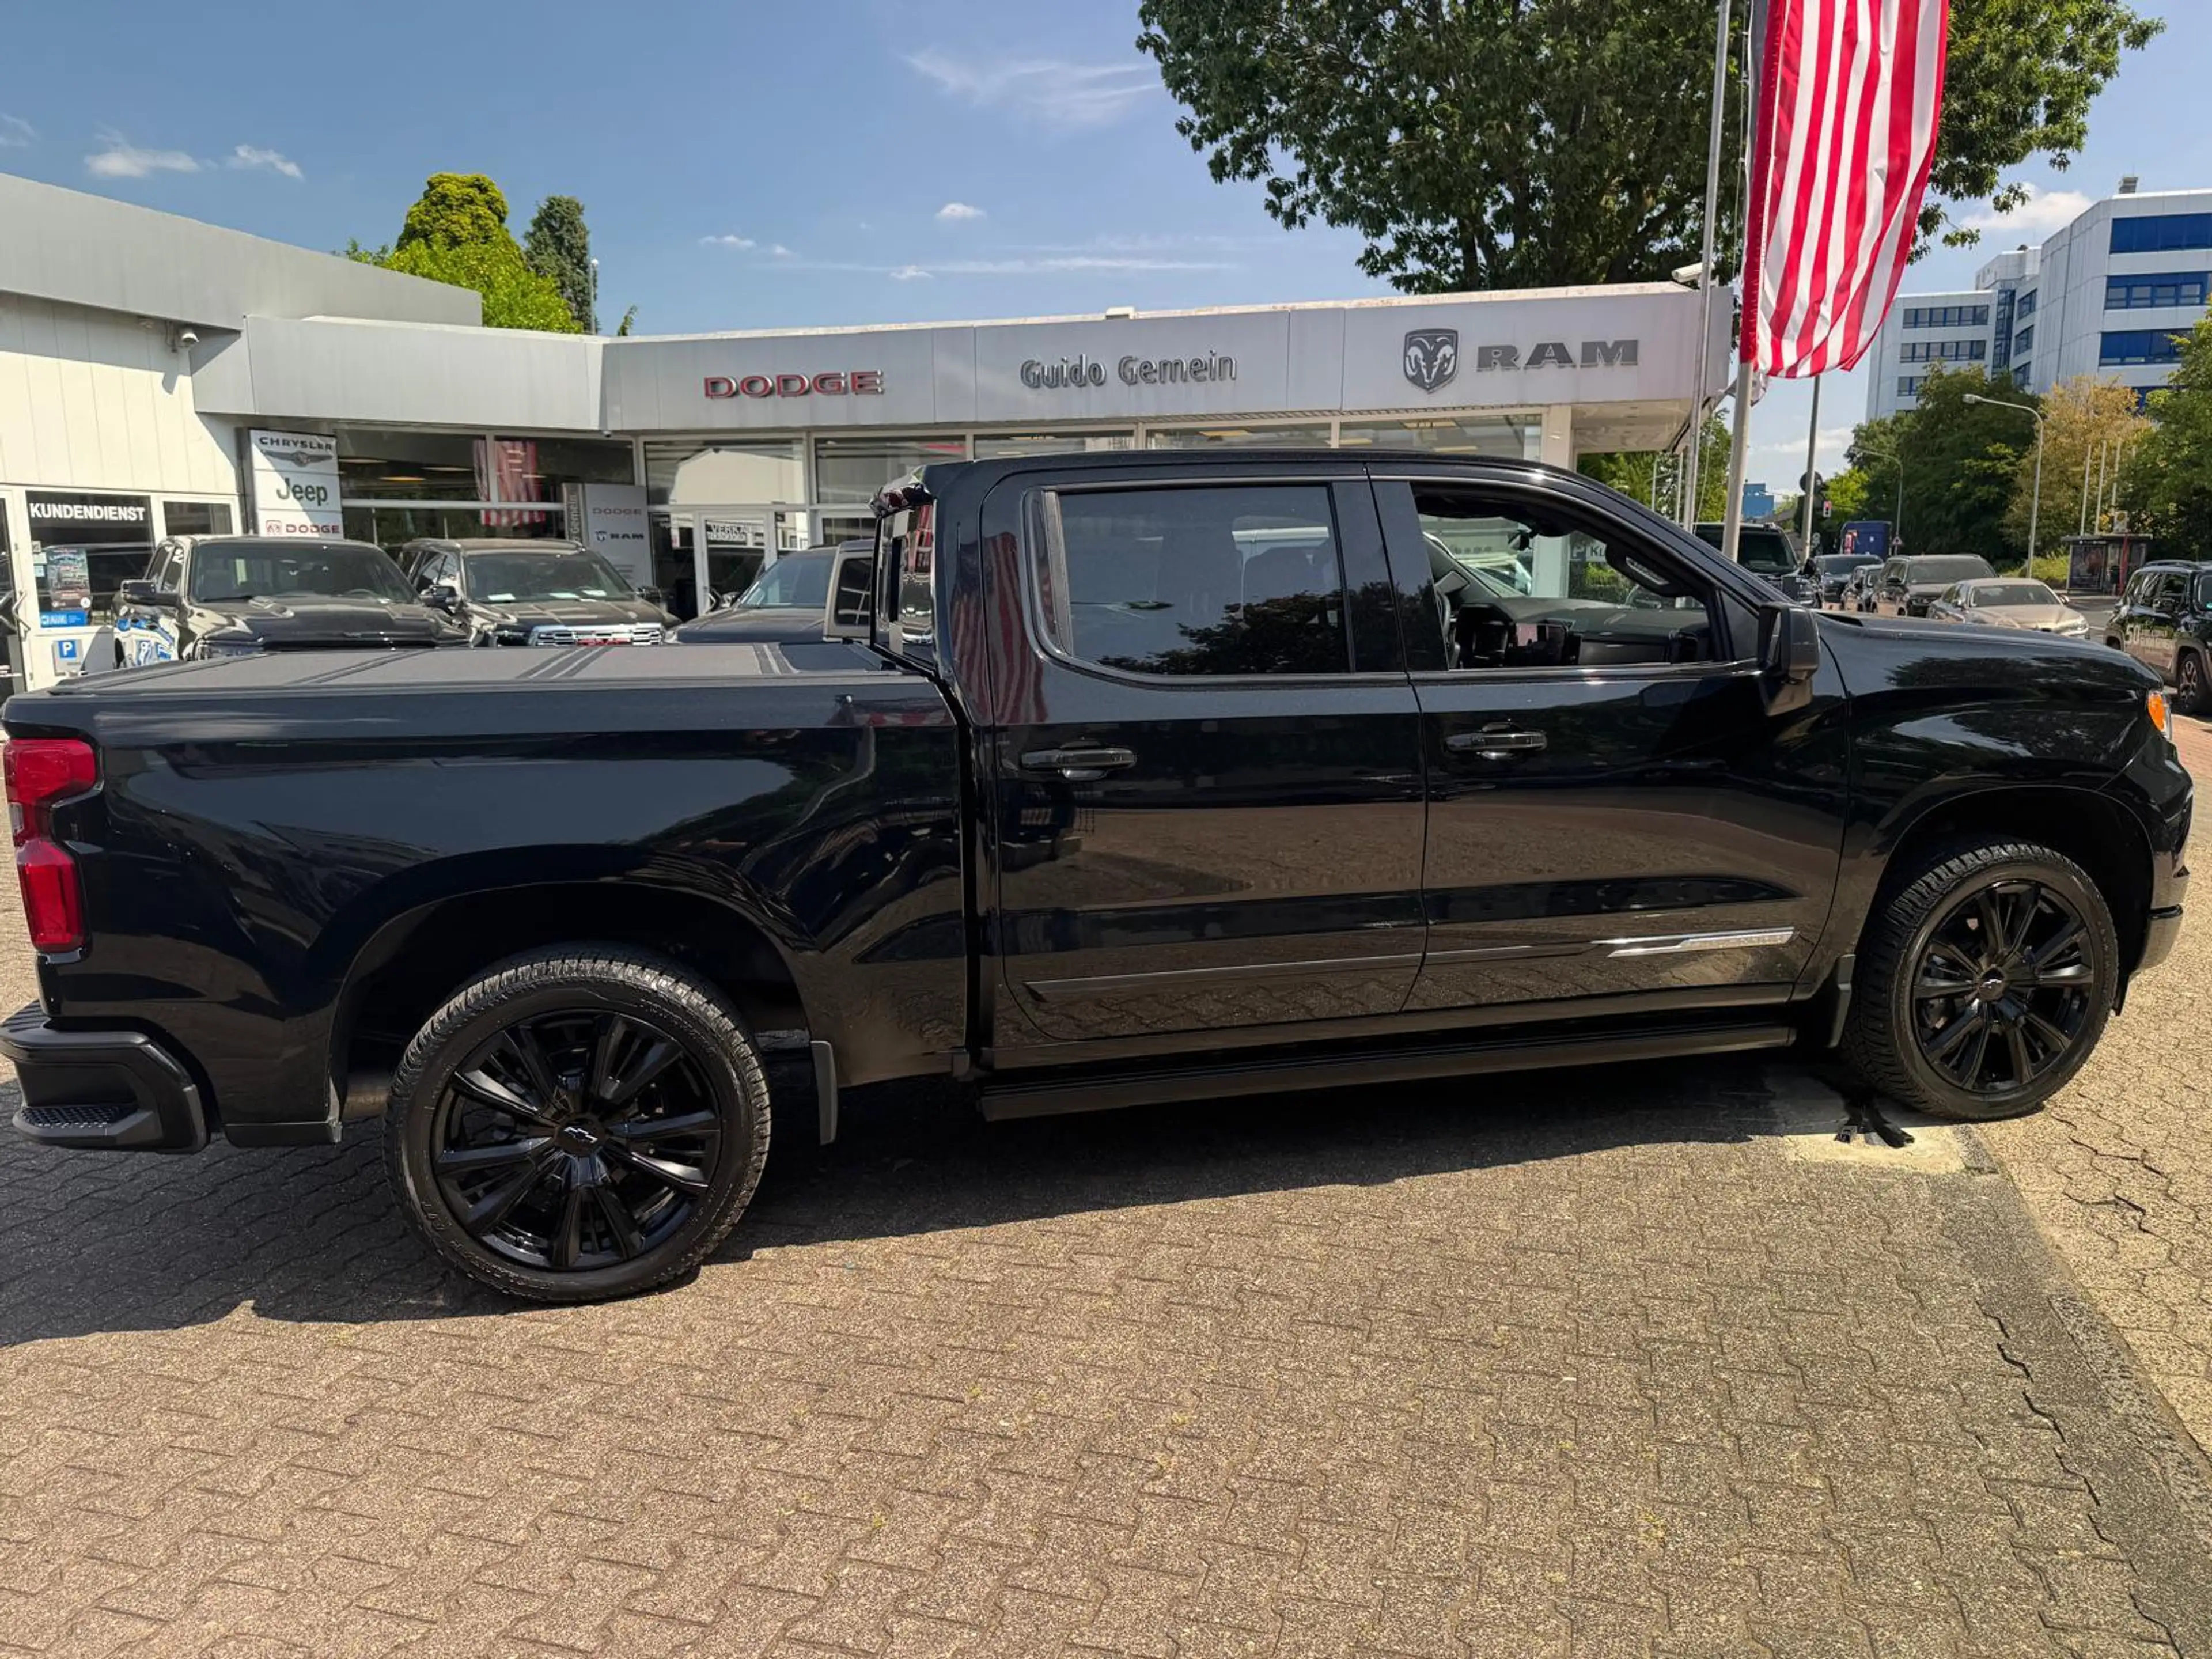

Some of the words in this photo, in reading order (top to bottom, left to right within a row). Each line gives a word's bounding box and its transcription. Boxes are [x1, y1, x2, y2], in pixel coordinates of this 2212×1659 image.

[1476, 339, 1639, 372] RAM
[1020, 353, 1107, 389] Guido
[1118, 349, 1237, 387] Gemein
[704, 370, 884, 399] DODGE
[259, 437, 332, 450] CHRYSLER
[276, 477, 328, 506] Jeep
[29, 502, 146, 521] KUNDENDIENST
[592, 507, 642, 515] DODGE
[286, 524, 340, 534] DODGE
[62, 641, 73, 657] P
